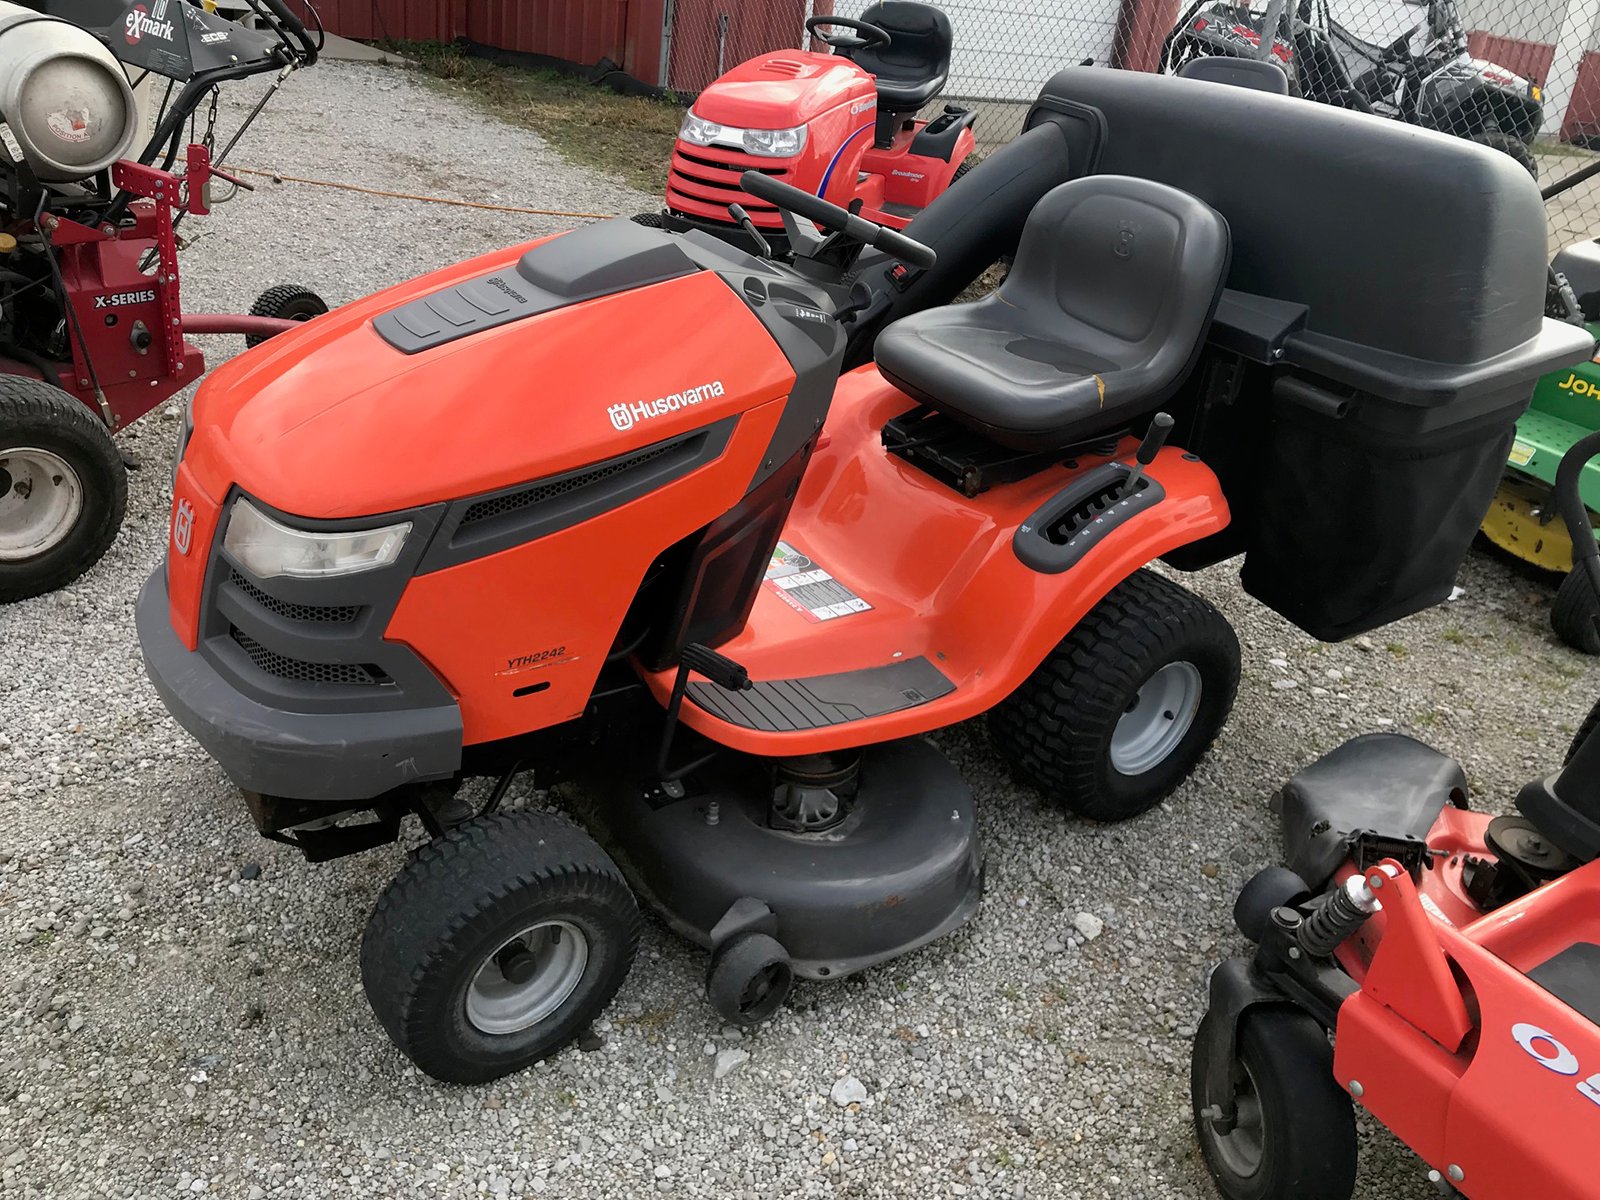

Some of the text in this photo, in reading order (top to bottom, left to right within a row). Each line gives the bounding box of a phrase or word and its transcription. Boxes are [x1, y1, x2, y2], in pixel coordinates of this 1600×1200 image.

[52, 123, 82, 140] POSITION
[95, 290, 155, 308] X-SERIES
[629, 380, 725, 422] Husqvarna
[507, 646, 566, 669] YTH2242
